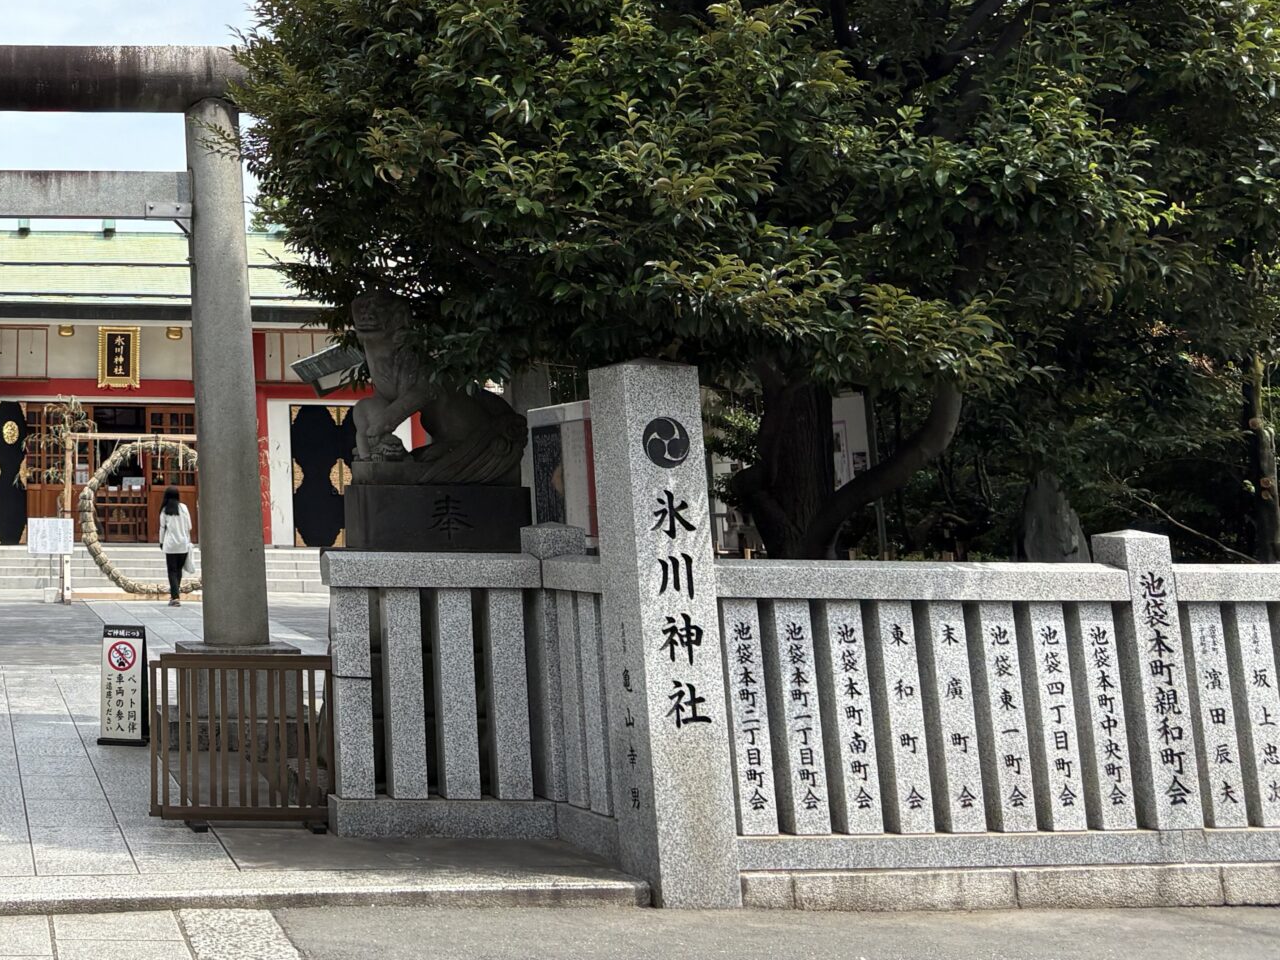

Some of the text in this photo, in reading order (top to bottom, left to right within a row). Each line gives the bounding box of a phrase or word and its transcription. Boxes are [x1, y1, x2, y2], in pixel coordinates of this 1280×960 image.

[113, 335, 125, 375] 氷川神社
[650, 490, 712, 728] 氷川神社
[1139, 572, 1191, 806] 池袋本町親和町会
[128, 674, 138, 733] ペット同伴
[733, 622, 768, 811] 池袋本町二丁目町会
[785, 622, 820, 810] 池袋本町一丁目町会
[837, 624, 873, 809] 池袋本町南町会
[890, 623, 925, 810] 東和町会
[941, 624, 976, 809] 末廣町会
[990, 625, 1027, 808] 池袋東一町会
[1040, 625, 1077, 807] 池袋四丁目町会
[1090, 626, 1127, 806] 池袋本町中央町会
